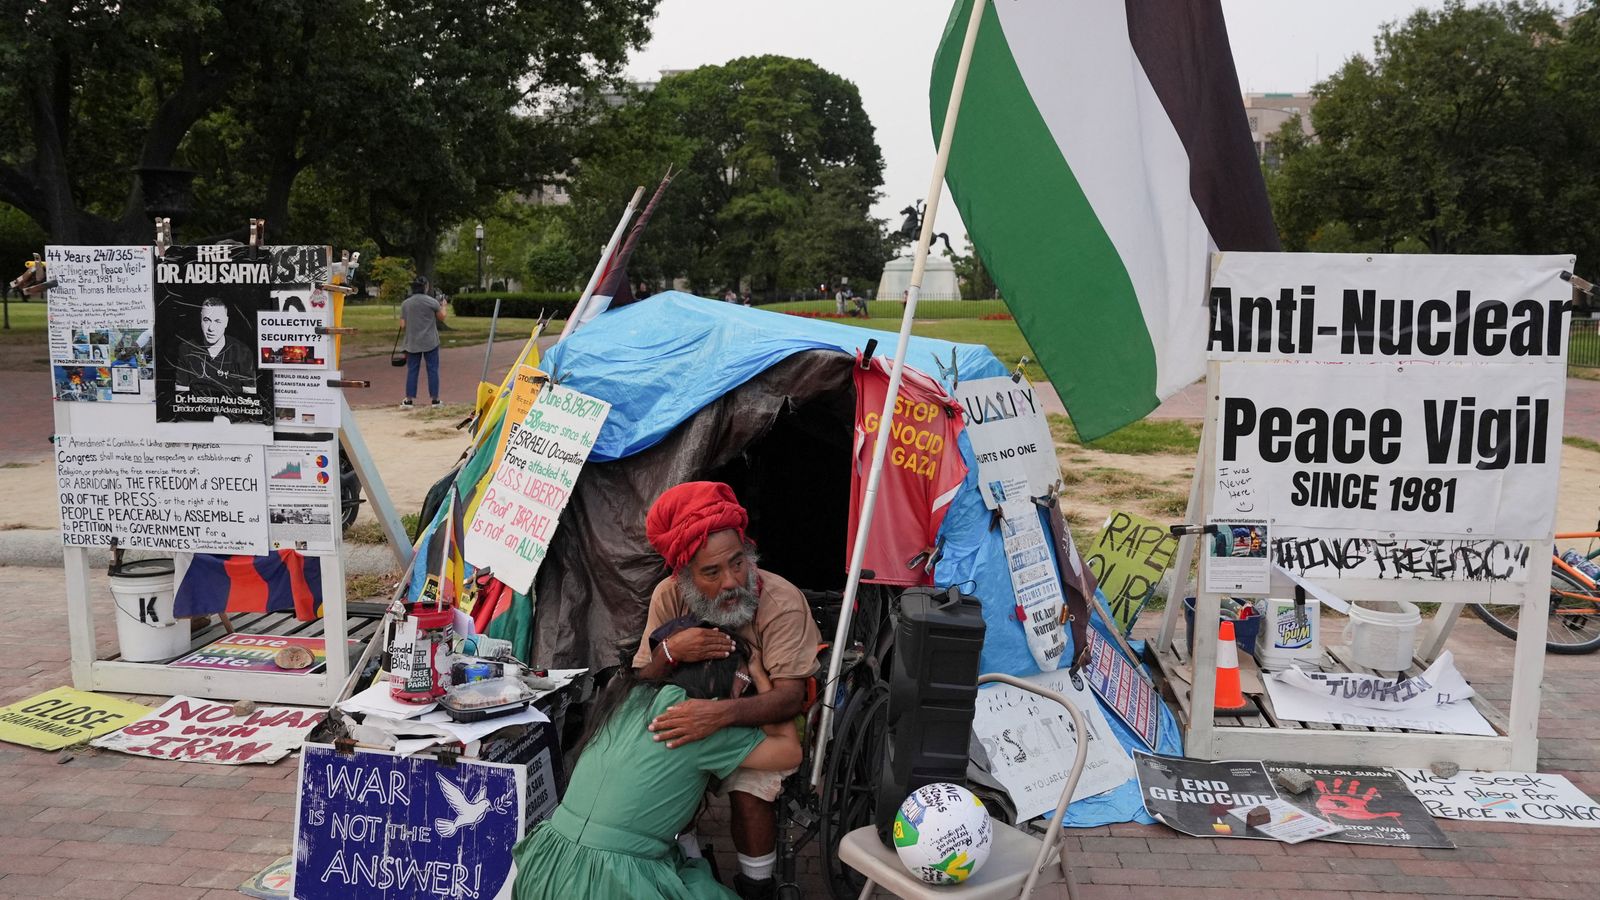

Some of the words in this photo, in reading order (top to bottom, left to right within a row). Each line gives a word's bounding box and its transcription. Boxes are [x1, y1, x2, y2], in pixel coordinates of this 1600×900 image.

[47, 249, 61, 261] 44
[64, 249, 91, 263] Years
[197, 245, 232, 262] FREE
[157, 264, 183, 284] DR.
[184, 264, 217, 284] ABU
[219, 264, 270, 284] SAFIYA
[260, 318, 323, 327] COLLECTIVE
[1207, 286, 1572, 356] Anti-Nuclear
[260, 333, 322, 341] SECURITY??
[175, 394, 187, 404] Dr.
[187, 394, 220, 404] Hussam
[220, 395, 237, 405] Abu
[237, 396, 260, 407] Safiya
[539, 391, 562, 409] June
[894, 396, 938, 424] STOP
[560, 425, 579, 441] since
[580, 431, 593, 448] the
[1222, 397, 1402, 464] Peace
[1423, 396, 1550, 470] Vigil
[58, 450, 97, 465] Congress
[115, 453, 131, 461] make
[156, 454, 185, 463] respecting
[244, 454, 253, 463] of
[513, 429, 550, 456] ISRAELI
[547, 442, 584, 468] Occupation
[1000, 448, 1015, 460] NO
[1017, 443, 1037, 456] ONE
[131, 467, 142, 475] free
[504, 446, 527, 469] Force
[528, 461, 560, 480] attacked
[560, 469, 573, 488] the
[891, 446, 937, 480] GAZA
[1219, 468, 1228, 476] I
[1233, 467, 1250, 475] was
[59, 478, 71, 489] OR
[73, 478, 122, 490] ABRIDGING
[126, 477, 145, 489] THE
[148, 476, 198, 490] FREEDOM
[200, 479, 208, 490] of
[211, 477, 257, 492] SPEECH
[1219, 477, 1252, 490] Never
[1291, 471, 1379, 511] SINCE
[1388, 476, 1457, 513] 1981
[60, 493, 74, 505] OR
[77, 493, 89, 504] OF
[90, 494, 109, 506] THE
[174, 497, 185, 505] the
[188, 497, 204, 507] right
[217, 497, 228, 506] the
[523, 476, 568, 511] LIBERTY
[481, 488, 513, 519] Proof
[62, 506, 104, 521] PEOPLE
[108, 508, 171, 522] PEACEABLY
[174, 511, 182, 521] to
[184, 510, 245, 523] ASSEMBLE
[248, 514, 259, 523] and
[63, 522, 70, 530] to
[72, 521, 112, 533] PETITION
[116, 523, 128, 533] the
[130, 523, 200, 537] GOVERNMENT
[205, 527, 218, 536] for
[473, 514, 484, 533] is
[483, 522, 505, 541] not
[505, 534, 519, 551] an
[63, 533, 111, 545] REDRESS
[118, 537, 125, 545] of
[130, 536, 190, 549] GRIEVANCES
[1099, 512, 1180, 573] RAPE
[139, 596, 159, 624] K
[220, 635, 288, 648] Love
[1283, 624, 1310, 646] Wind
[205, 645, 278, 660] trum
[388, 641, 413, 654] donald
[21, 699, 125, 729] CLOSE
[159, 701, 234, 722] NO
[243, 709, 328, 728] WAR
[0, 712, 82, 737] GUANTANAMO
[127, 736, 273, 761] IRAN
[326, 764, 411, 806] WAR
[1181, 779, 1230, 792] END
[1397, 769, 1456, 785] We
[1468, 774, 1556, 788] seek
[1149, 786, 1271, 806] GENOCIDE
[1414, 785, 1454, 797] and
[1464, 787, 1518, 801] plea
[1521, 788, 1560, 801] for
[1421, 800, 1496, 819] PEACE
[1505, 811, 1520, 819] IN
[308, 809, 325, 827] IS
[331, 812, 382, 843] NOT
[388, 819, 432, 843] THE
[320, 850, 481, 900] ANSWER!
